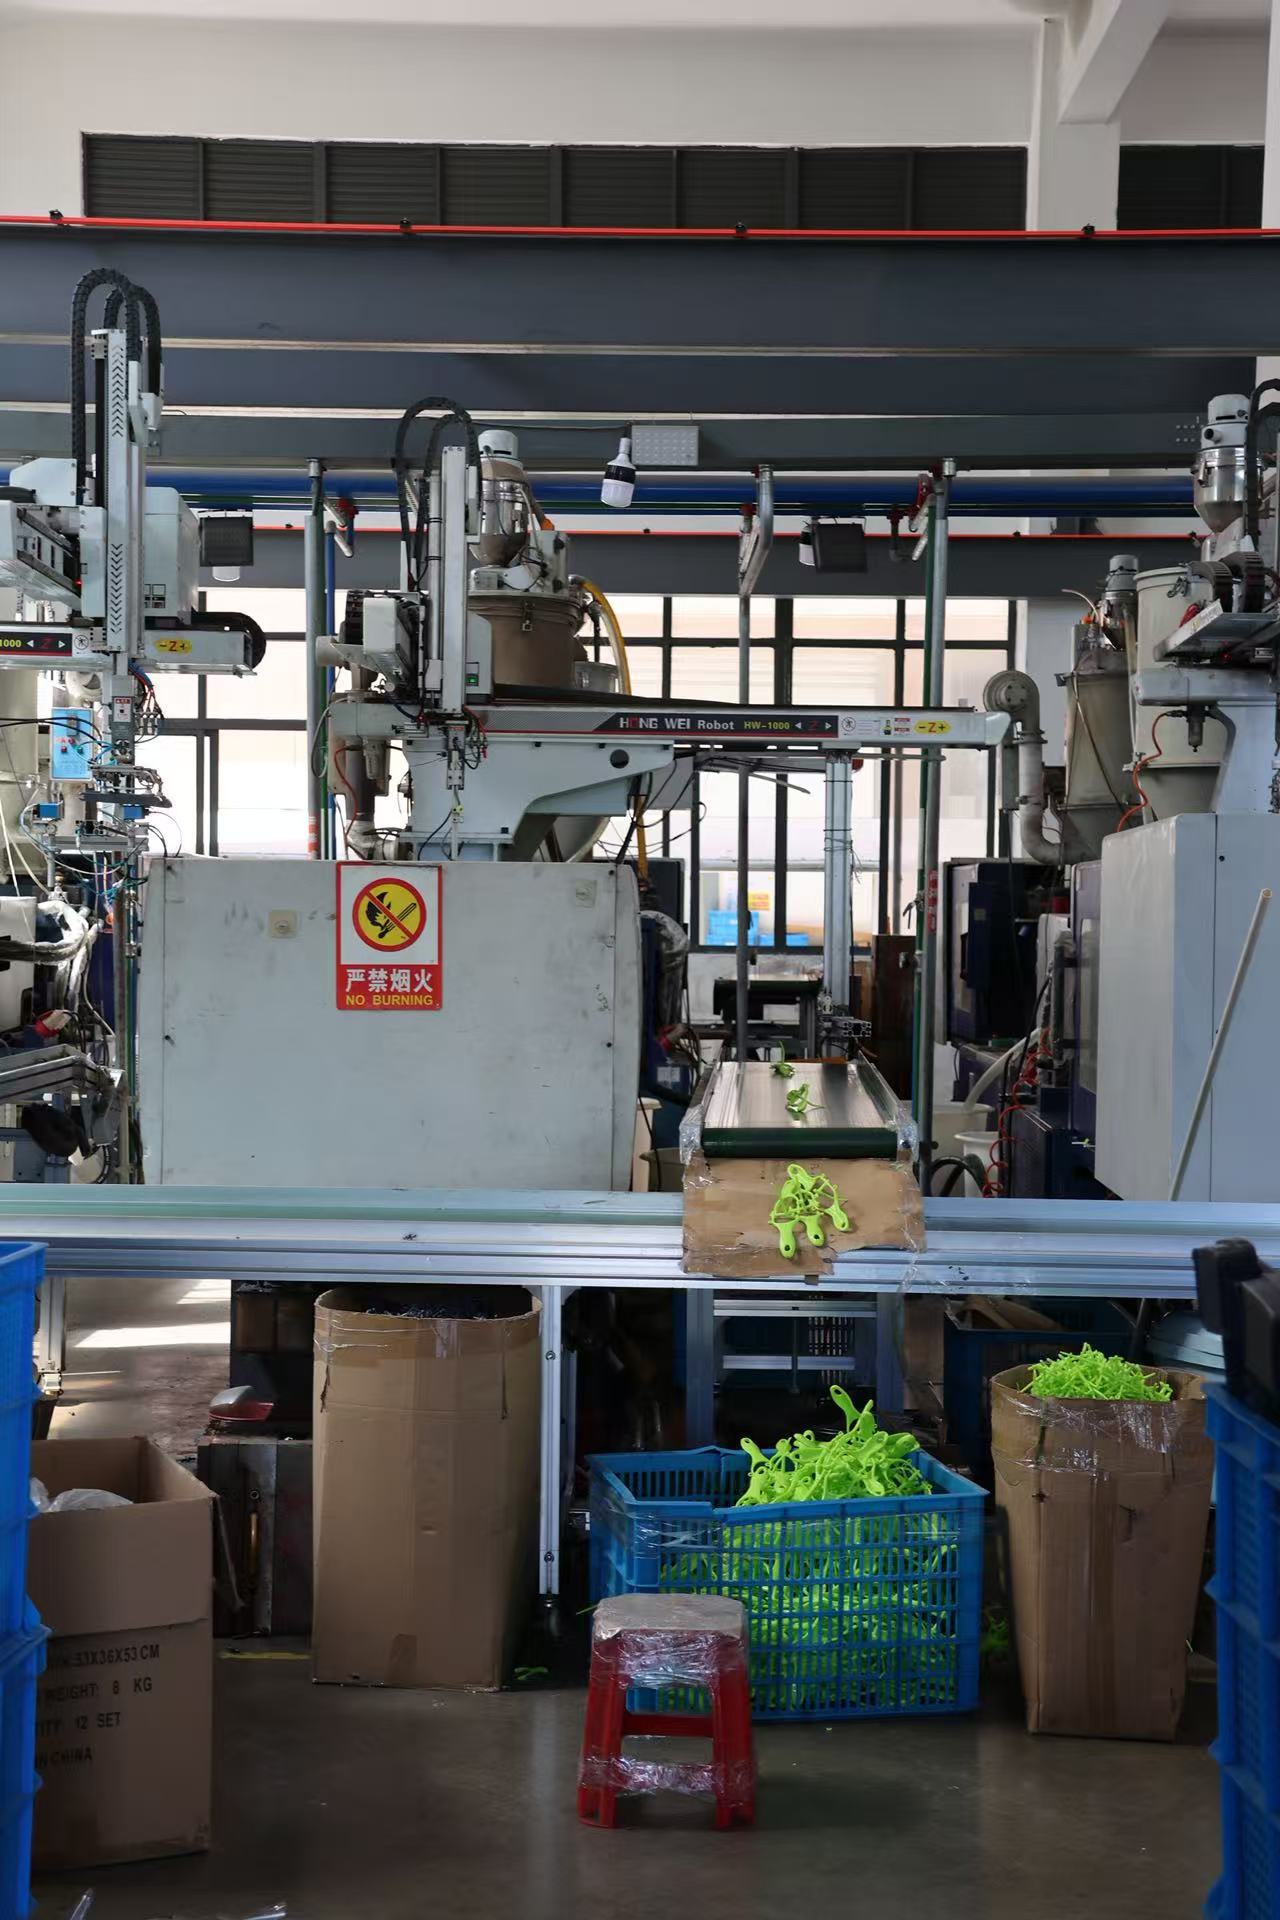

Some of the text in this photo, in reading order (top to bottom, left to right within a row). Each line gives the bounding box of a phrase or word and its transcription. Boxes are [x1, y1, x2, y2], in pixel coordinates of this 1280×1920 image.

[664, 718, 691, 730] WEI
[697, 720, 735, 730] Robot
[743, 721, 790, 731] HW-1000
[345, 968, 433, 993] 严禁烟火
[345, 994, 433, 1006] NO BURNING
[133, 1677, 153, 1693] KG
[97, 1712, 121, 1728] SET
